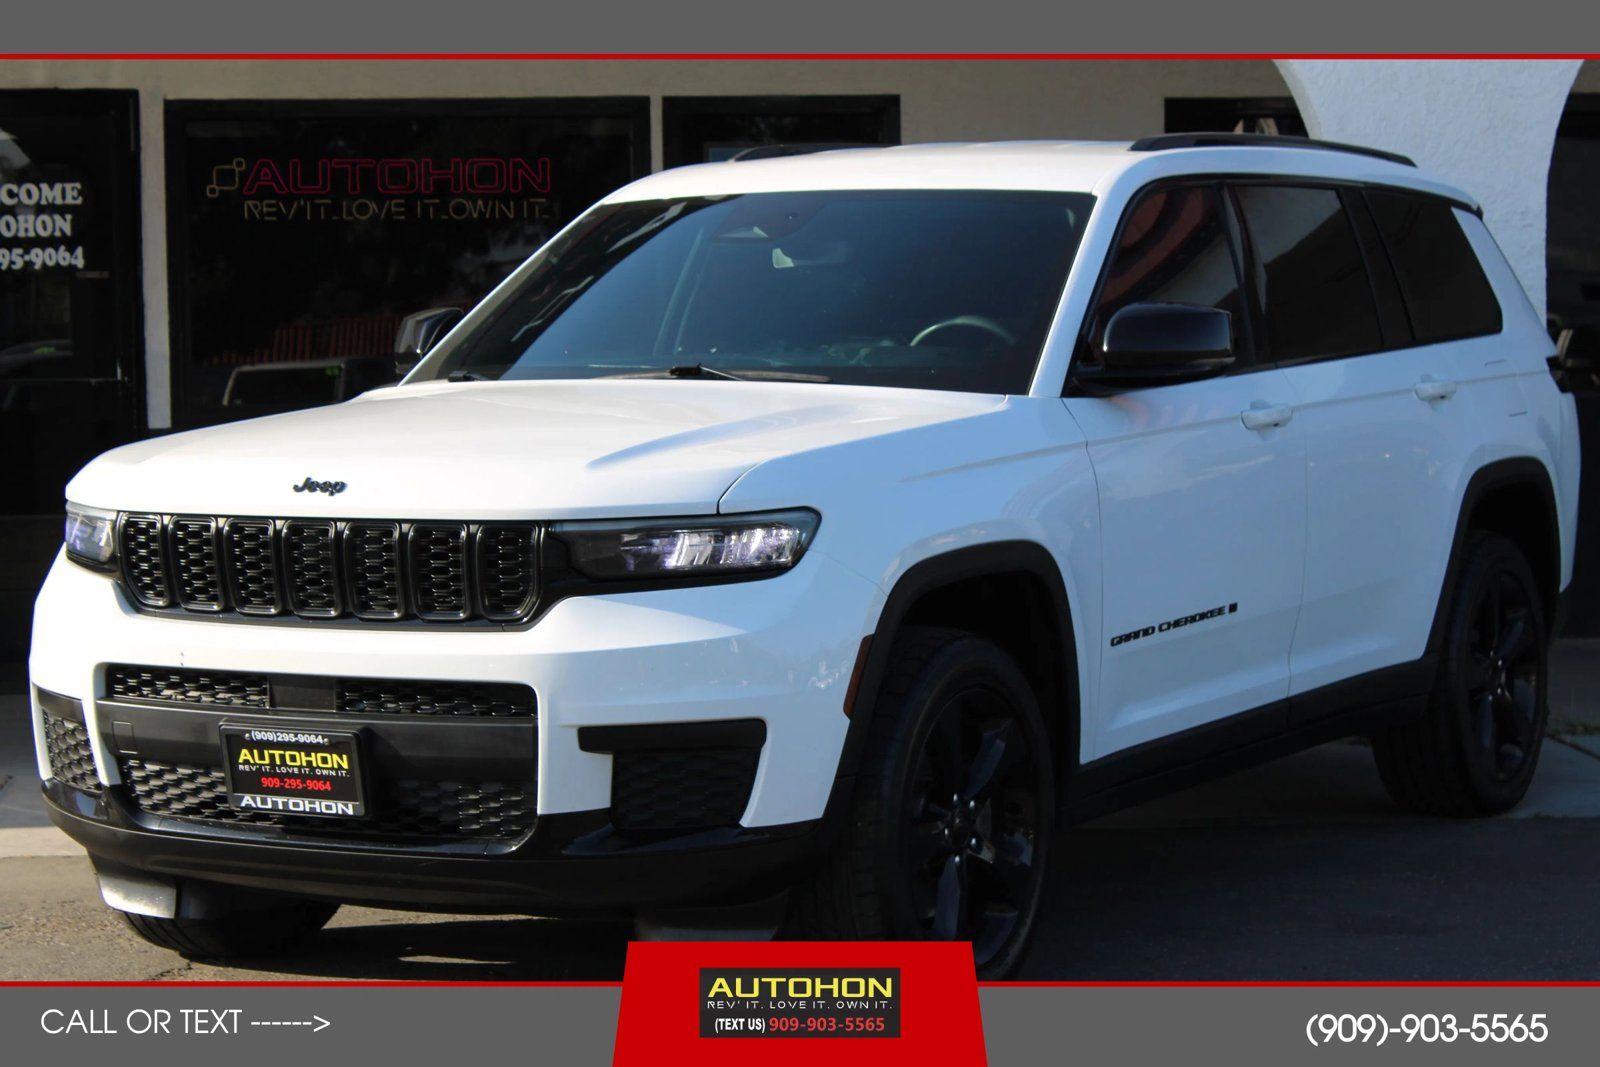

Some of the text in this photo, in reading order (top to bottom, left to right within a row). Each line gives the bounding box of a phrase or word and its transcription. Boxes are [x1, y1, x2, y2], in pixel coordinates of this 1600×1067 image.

[242, 157, 551, 195] AUTOHON
[0, 182, 83, 206] COME
[0, 214, 73, 238] OHON
[292, 476, 348, 497] Jeep
[1110, 626, 1156, 647] GRAND
[1158, 605, 1227, 633] CHEROKEE
[251, 730, 324, 744] (909)295-9064
[238, 748, 349, 770] AUTOHON
[275, 766, 299, 774] LOVE
[315, 769, 336, 777] OWN
[261, 777, 332, 791] 909-295-9064
[240, 795, 355, 816] AUTOHON
